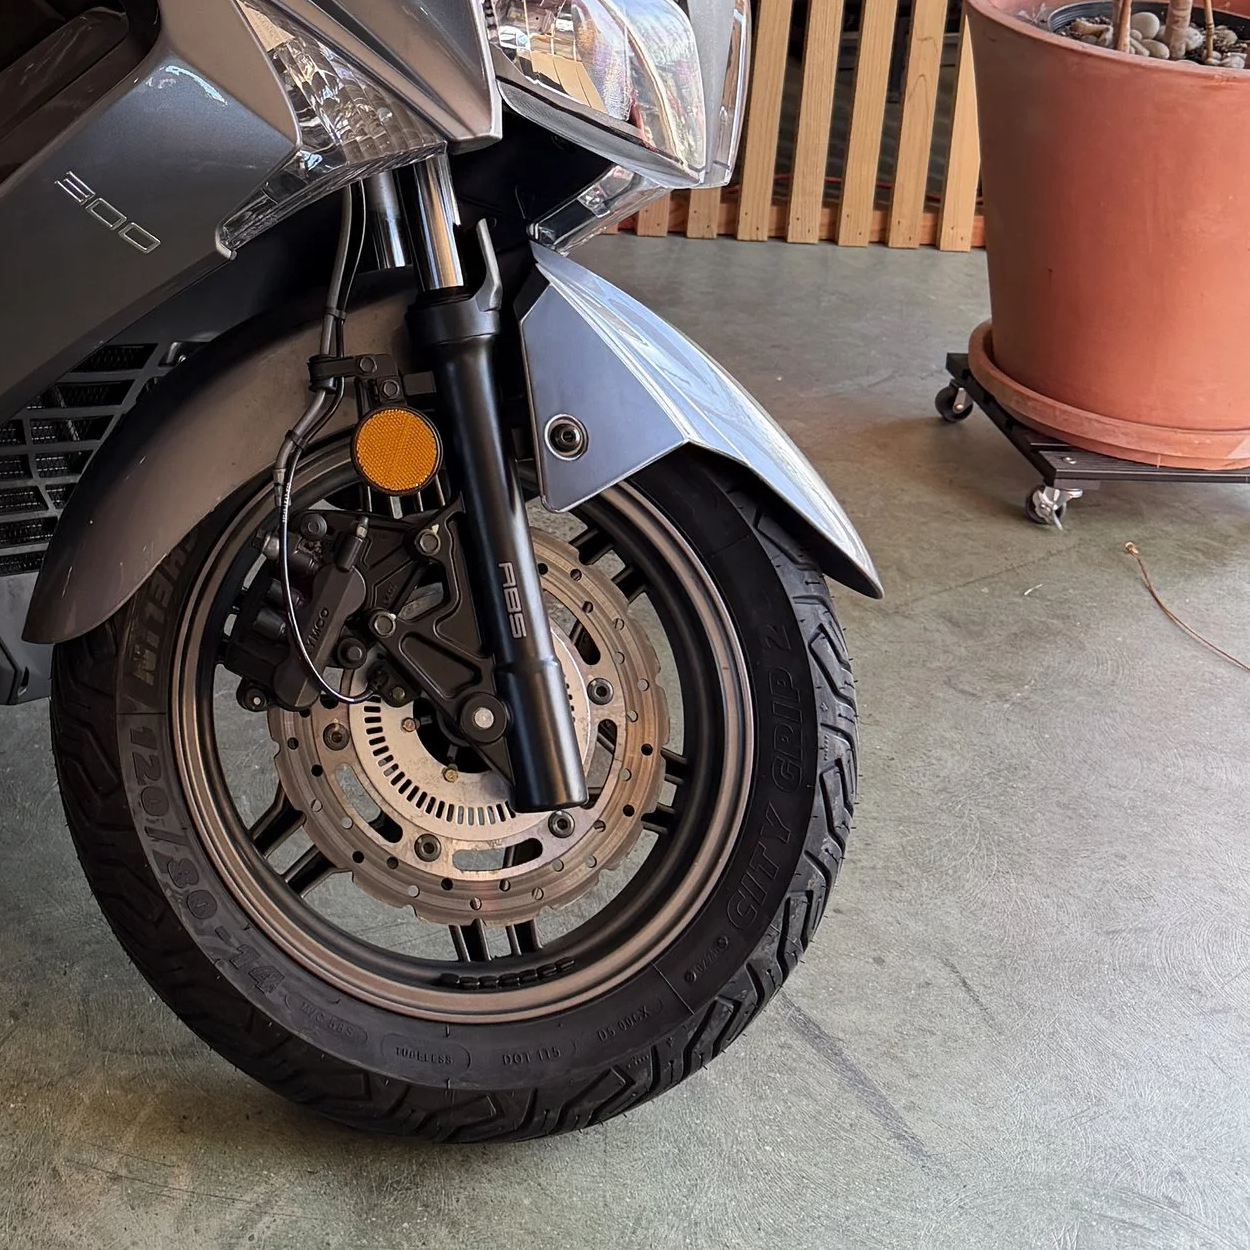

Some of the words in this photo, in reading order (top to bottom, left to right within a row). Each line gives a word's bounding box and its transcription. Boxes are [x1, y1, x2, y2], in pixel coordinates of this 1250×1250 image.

[54, 171, 161, 254] 300
[498, 562, 527, 639] ABS
[727, 802, 793, 932] CITY
[768, 666, 804, 794] GRIP
